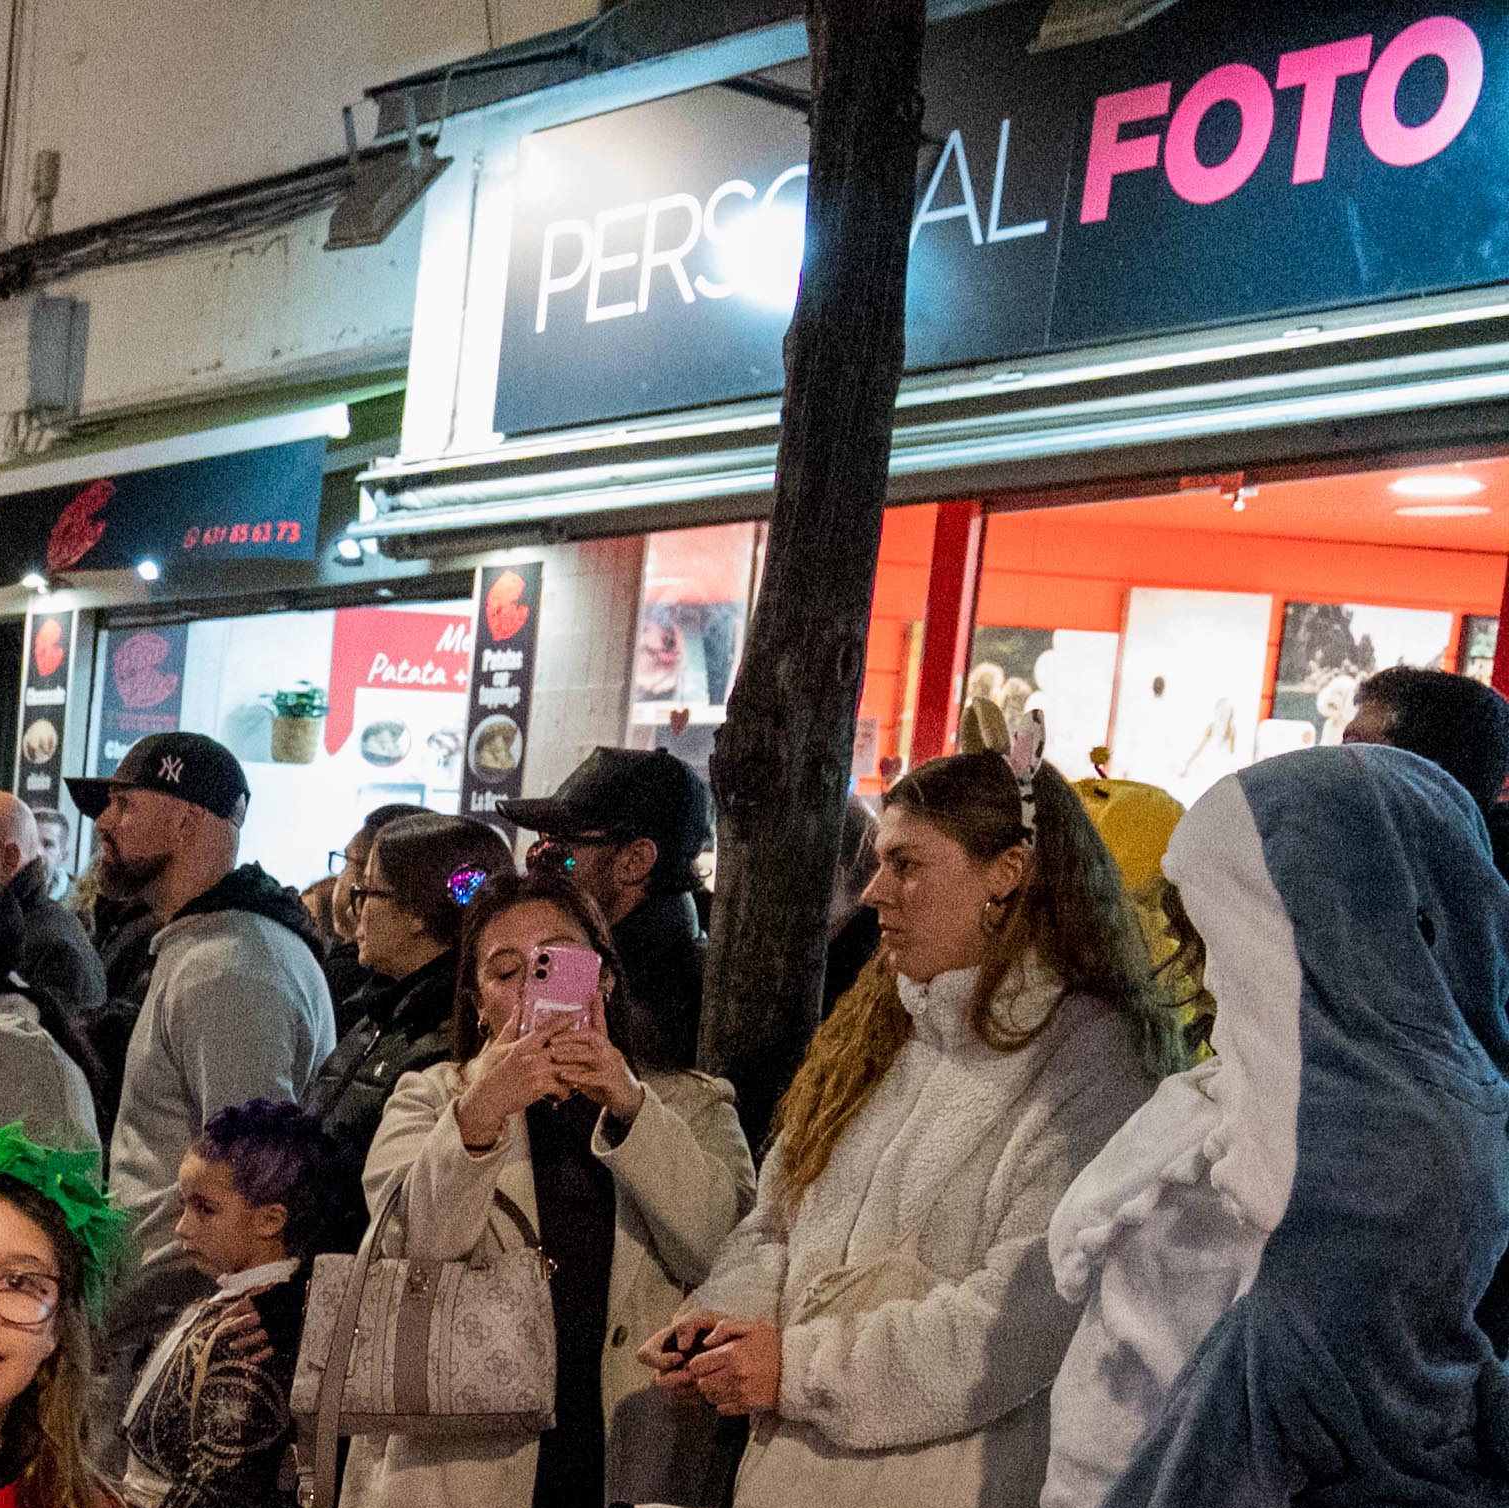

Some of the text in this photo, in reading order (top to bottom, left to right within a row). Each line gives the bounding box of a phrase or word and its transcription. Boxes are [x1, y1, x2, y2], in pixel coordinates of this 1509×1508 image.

[535, 14, 1485, 333] PERSAL FOTO
[435, 622, 472, 654] Me
[367, 652, 447, 685] Patata
[157, 754, 185, 784] NY
